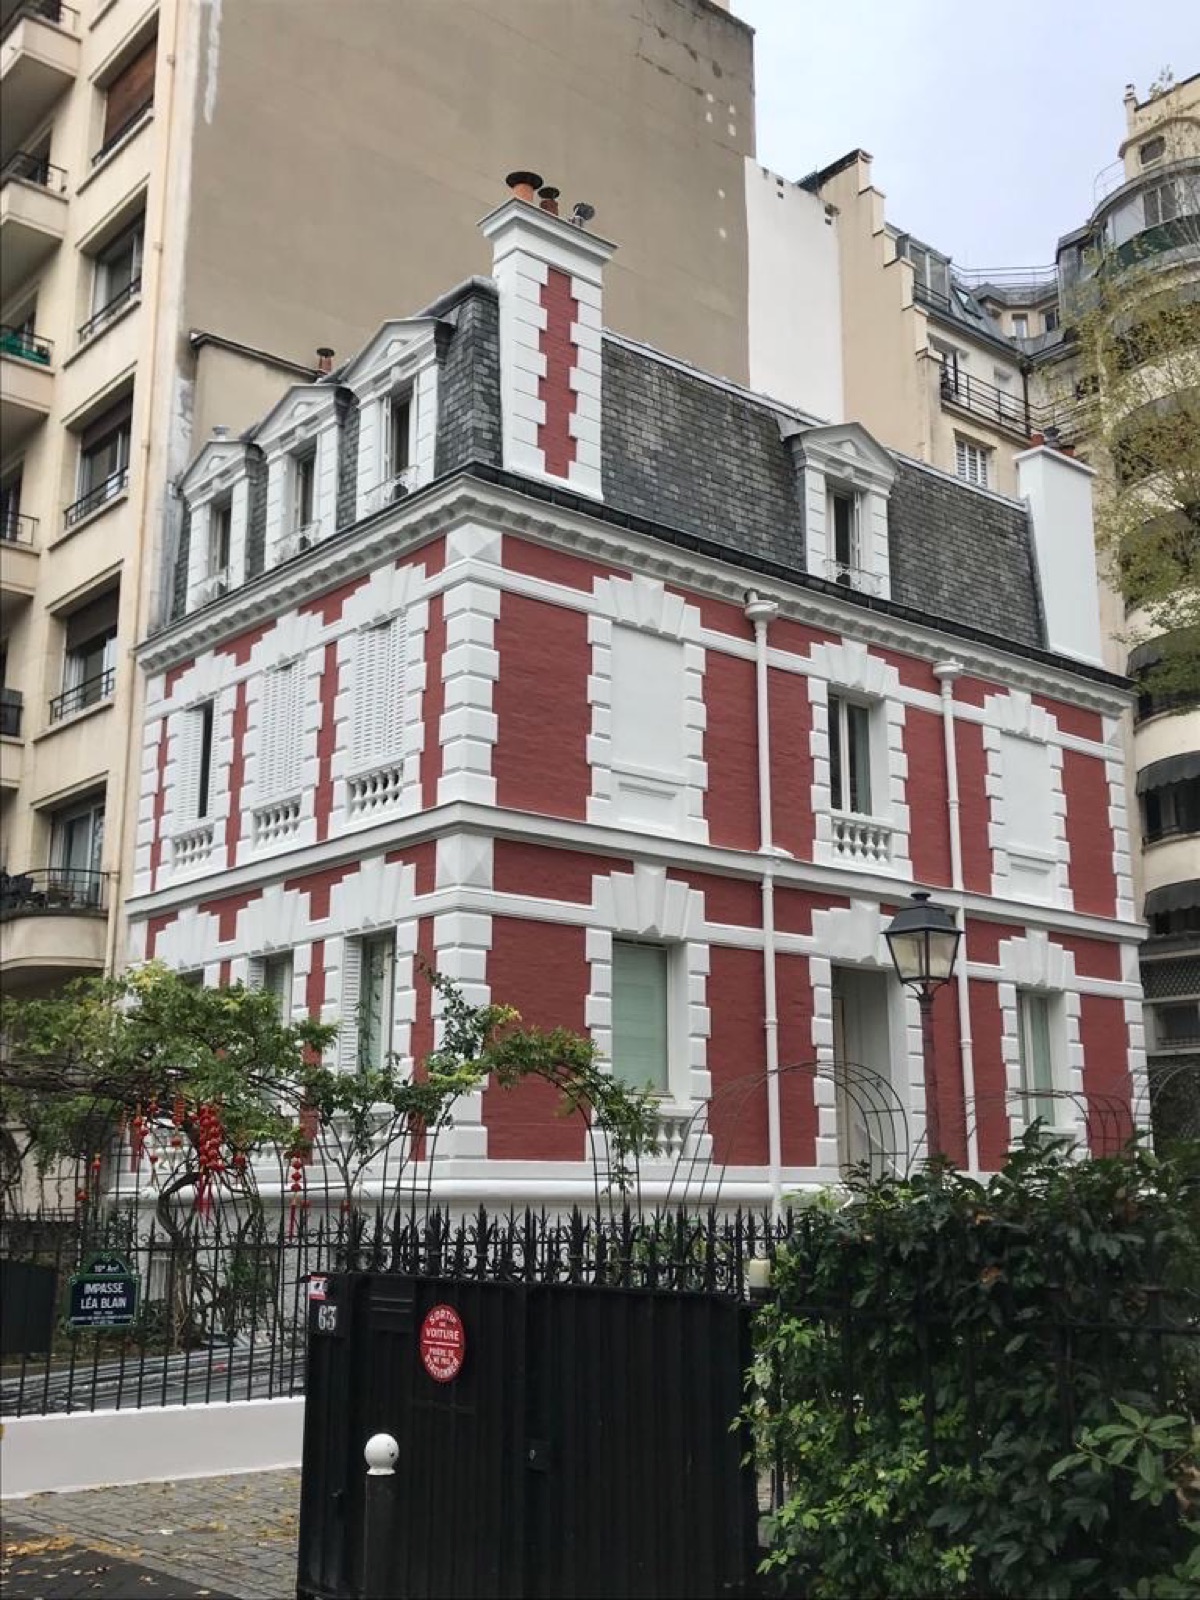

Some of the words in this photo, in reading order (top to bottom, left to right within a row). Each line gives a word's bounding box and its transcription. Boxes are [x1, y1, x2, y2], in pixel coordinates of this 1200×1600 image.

[84, 1282, 124, 1295] IMPASSE
[80, 1295, 98, 1310] LÉA
[101, 1297, 127, 1309] BLAIN
[318, 1304, 337, 1331] 63
[425, 1327, 460, 1342] VOITURE
